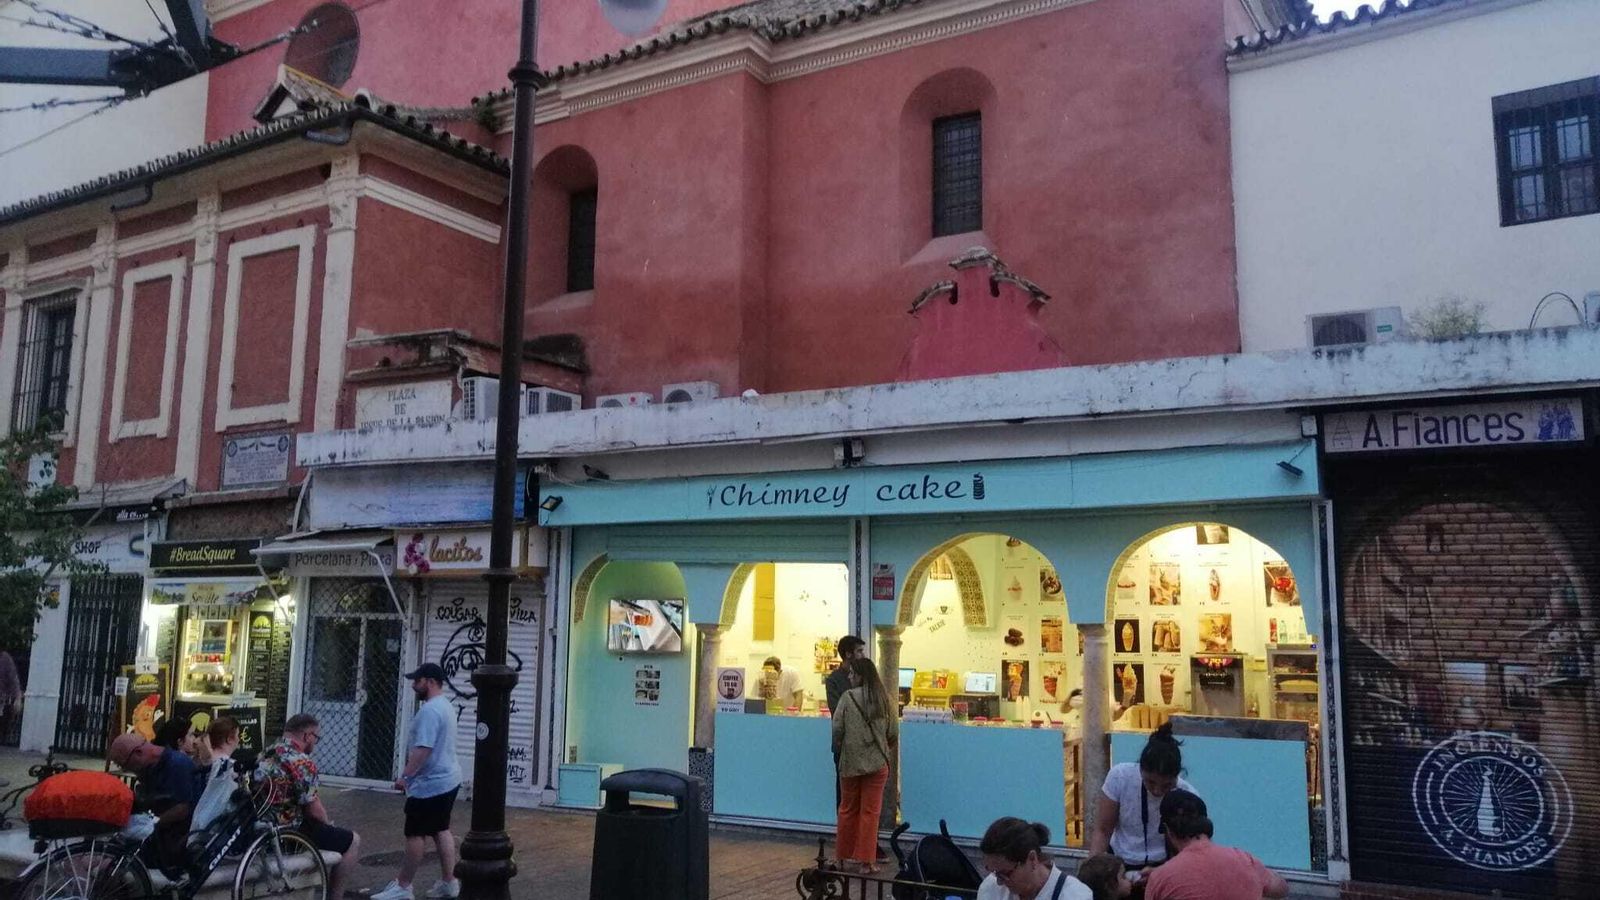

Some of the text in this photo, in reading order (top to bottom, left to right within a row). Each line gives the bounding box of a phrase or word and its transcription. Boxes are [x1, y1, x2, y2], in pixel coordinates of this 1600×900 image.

[387, 388, 417, 402] PLAZA
[394, 403, 407, 415] DE
[721, 474, 967, 508] Chimney cake
[169, 545, 236, 563] #BreadSquare
[295, 552, 351, 567] Porcelana
[1432, 737, 1547, 778] INCIENSOS
[1460, 835, 1548, 866] FIANCES
